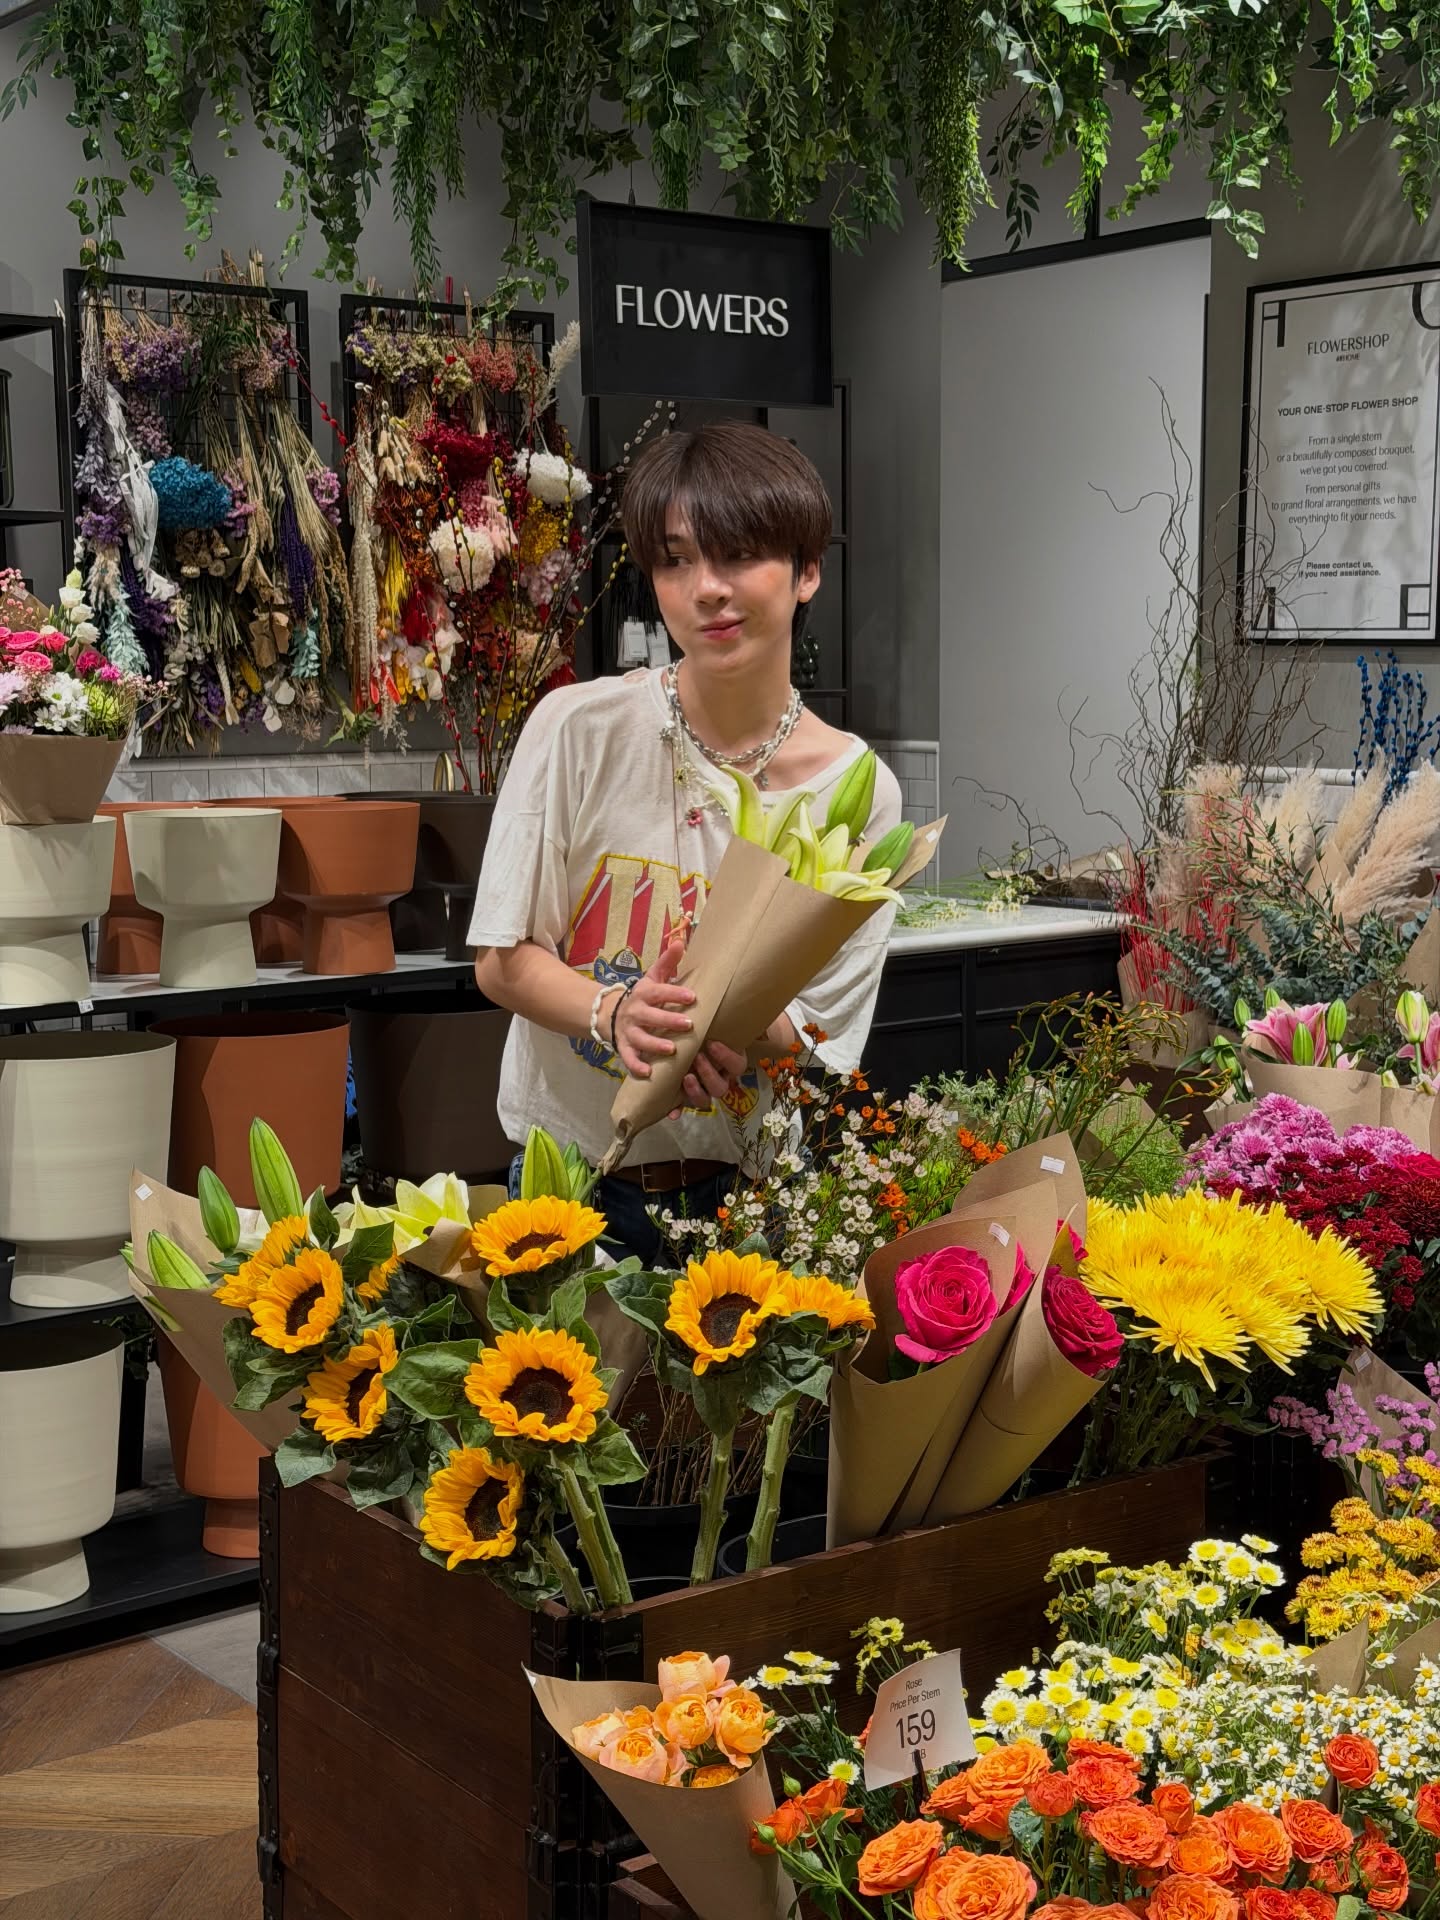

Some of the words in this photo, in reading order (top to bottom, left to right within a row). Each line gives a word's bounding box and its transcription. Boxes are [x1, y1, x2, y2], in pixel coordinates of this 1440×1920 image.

[615, 284, 790, 338] FLOWERS
[1307, 333, 1390, 356] FLOWERSHOP
[1277, 406, 1301, 416] YOUR
[1303, 402, 1349, 415] ONE-STOP
[1351, 399, 1389, 411] FLOWER
[1391, 396, 1419, 407] SHOP
[1308, 435, 1329, 446] From
[1330, 437, 1336, 445] a
[1337, 432, 1360, 446] single
[1361, 432, 1382, 442] stem
[1276, 454, 1286, 463] or
[1286, 454, 1292, 462] a
[1292, 450, 1333, 462] beautifully
[1334, 447, 1377, 460] composed
[1300, 465, 1321, 475] we've
[1322, 464, 1336, 476] got
[1337, 465, 1353, 475] you
[1354, 461, 1389, 472] covered.
[1305, 484, 1326, 495] From
[1327, 482, 1362, 496] personal
[1362, 481, 1381, 493] gifts
[1271, 501, 1280, 510] to
[1280, 500, 1303, 512] grand
[1304, 499, 1324, 509] floral
[1383, 497, 1396, 505] we
[1397, 494, 1417, 504] have
[1288, 513, 1330, 526] everything
[1330, 512, 1339, 521] to
[1340, 512, 1349, 521] fit
[1350, 512, 1368, 524] your
[1332, 561, 1361, 569] contact
[1305, 571, 1318, 579] you
[905, 1678, 923, 1691] Rose
[889, 1699, 907, 1712] Price
[907, 1694, 921, 1706] Per
[921, 1688, 941, 1702] Stem
[896, 1709, 936, 1748] 159
